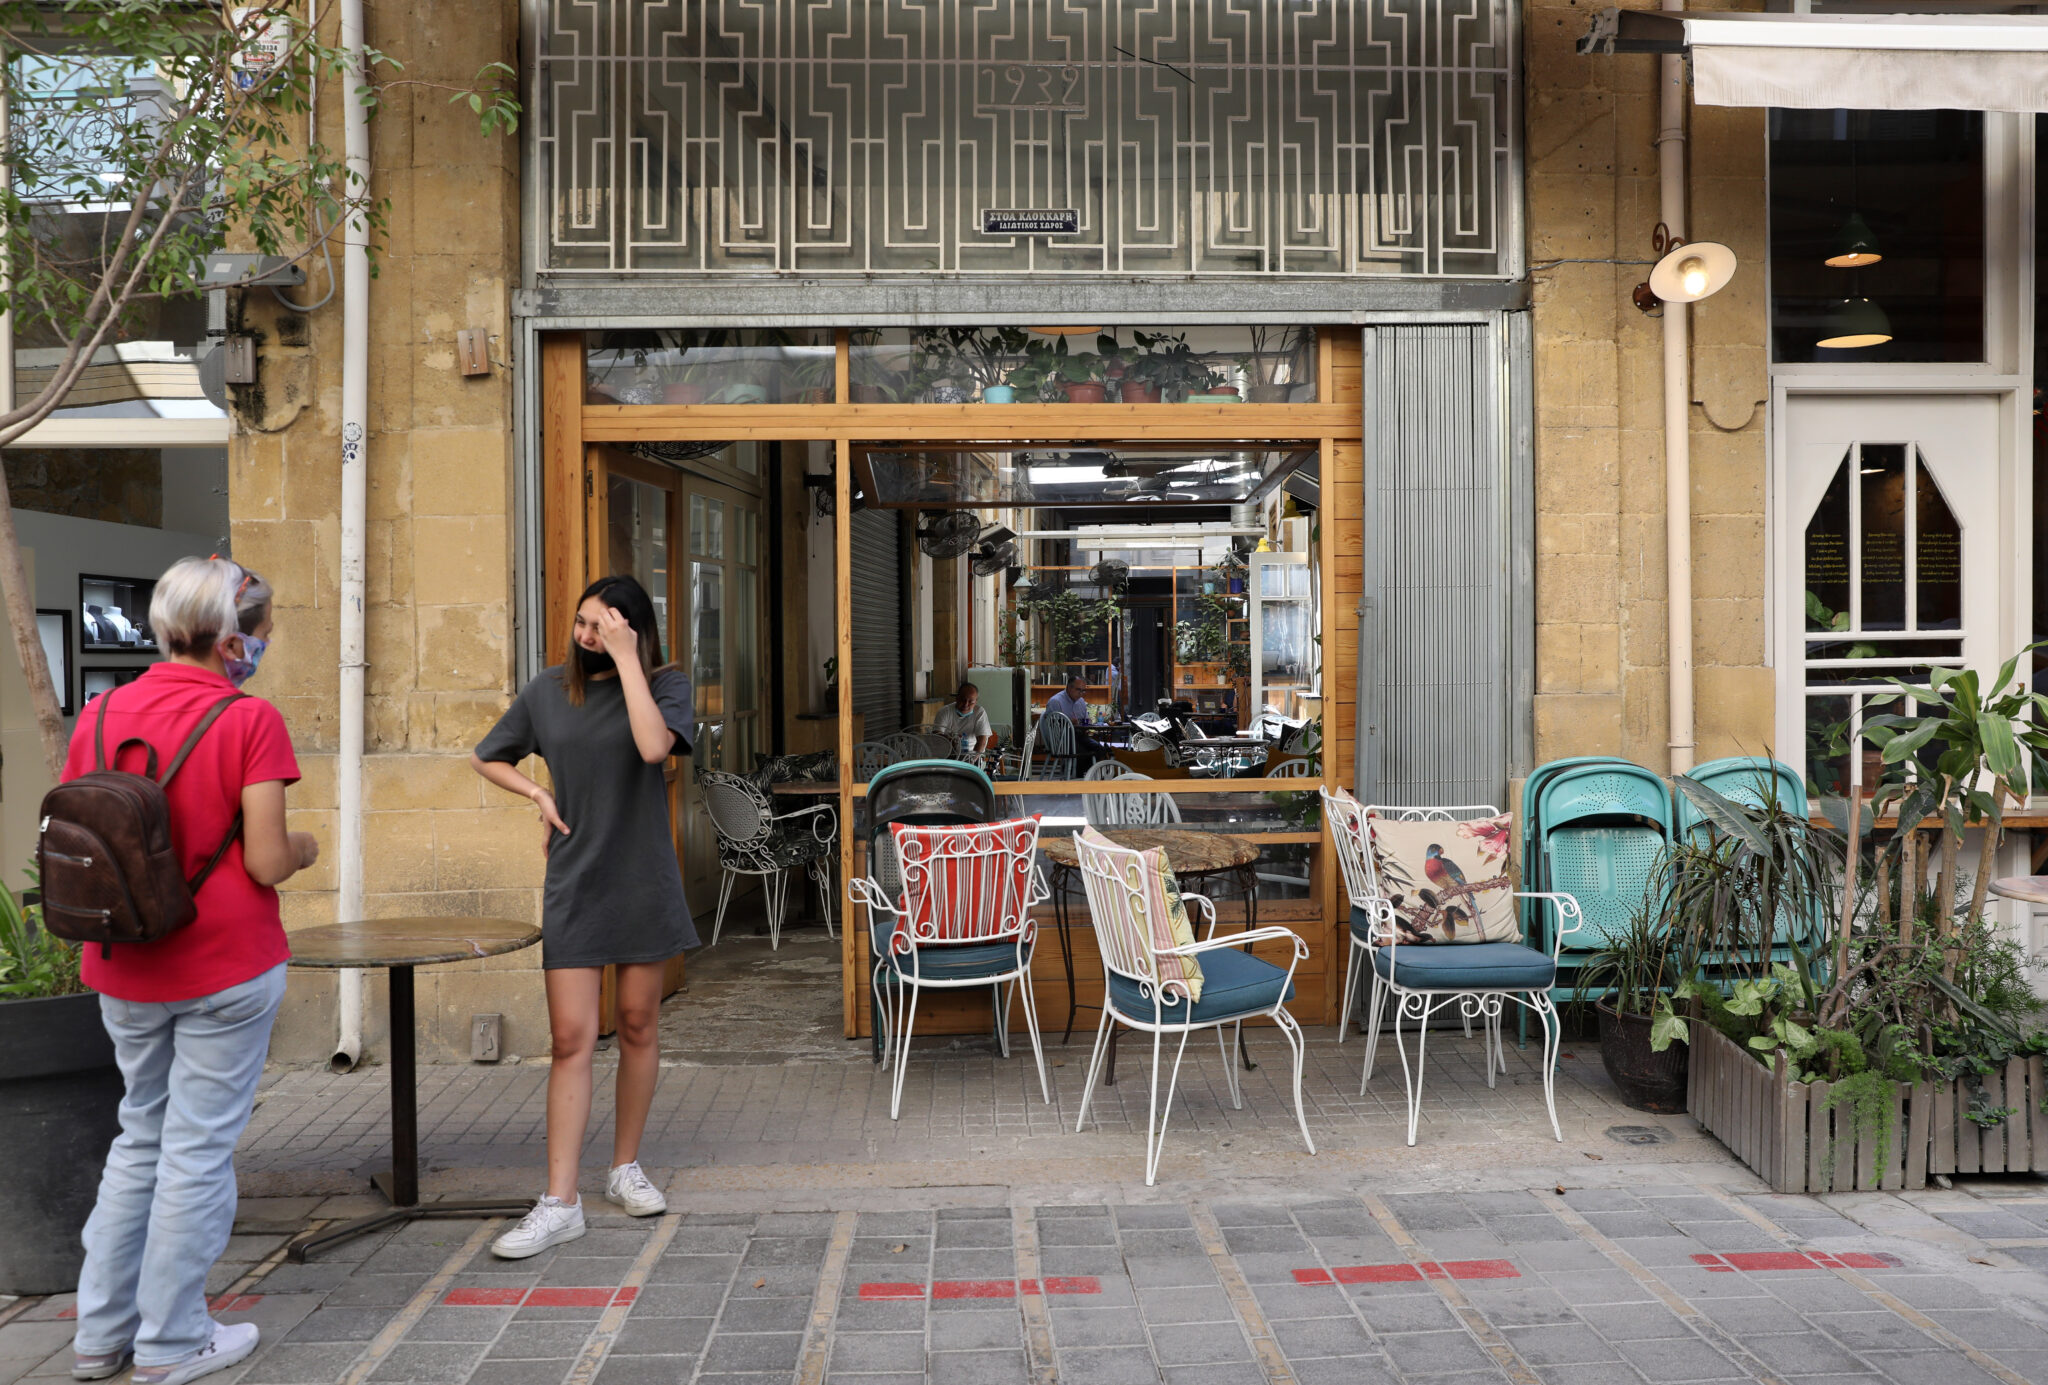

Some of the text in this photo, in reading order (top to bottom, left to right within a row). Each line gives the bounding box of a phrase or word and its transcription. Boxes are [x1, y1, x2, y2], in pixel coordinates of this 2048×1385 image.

[982, 64, 1080, 105] 1932
[989, 212, 1072, 221] ΣΤΟΑ ΚΛΟΚΚΑΡΗ
